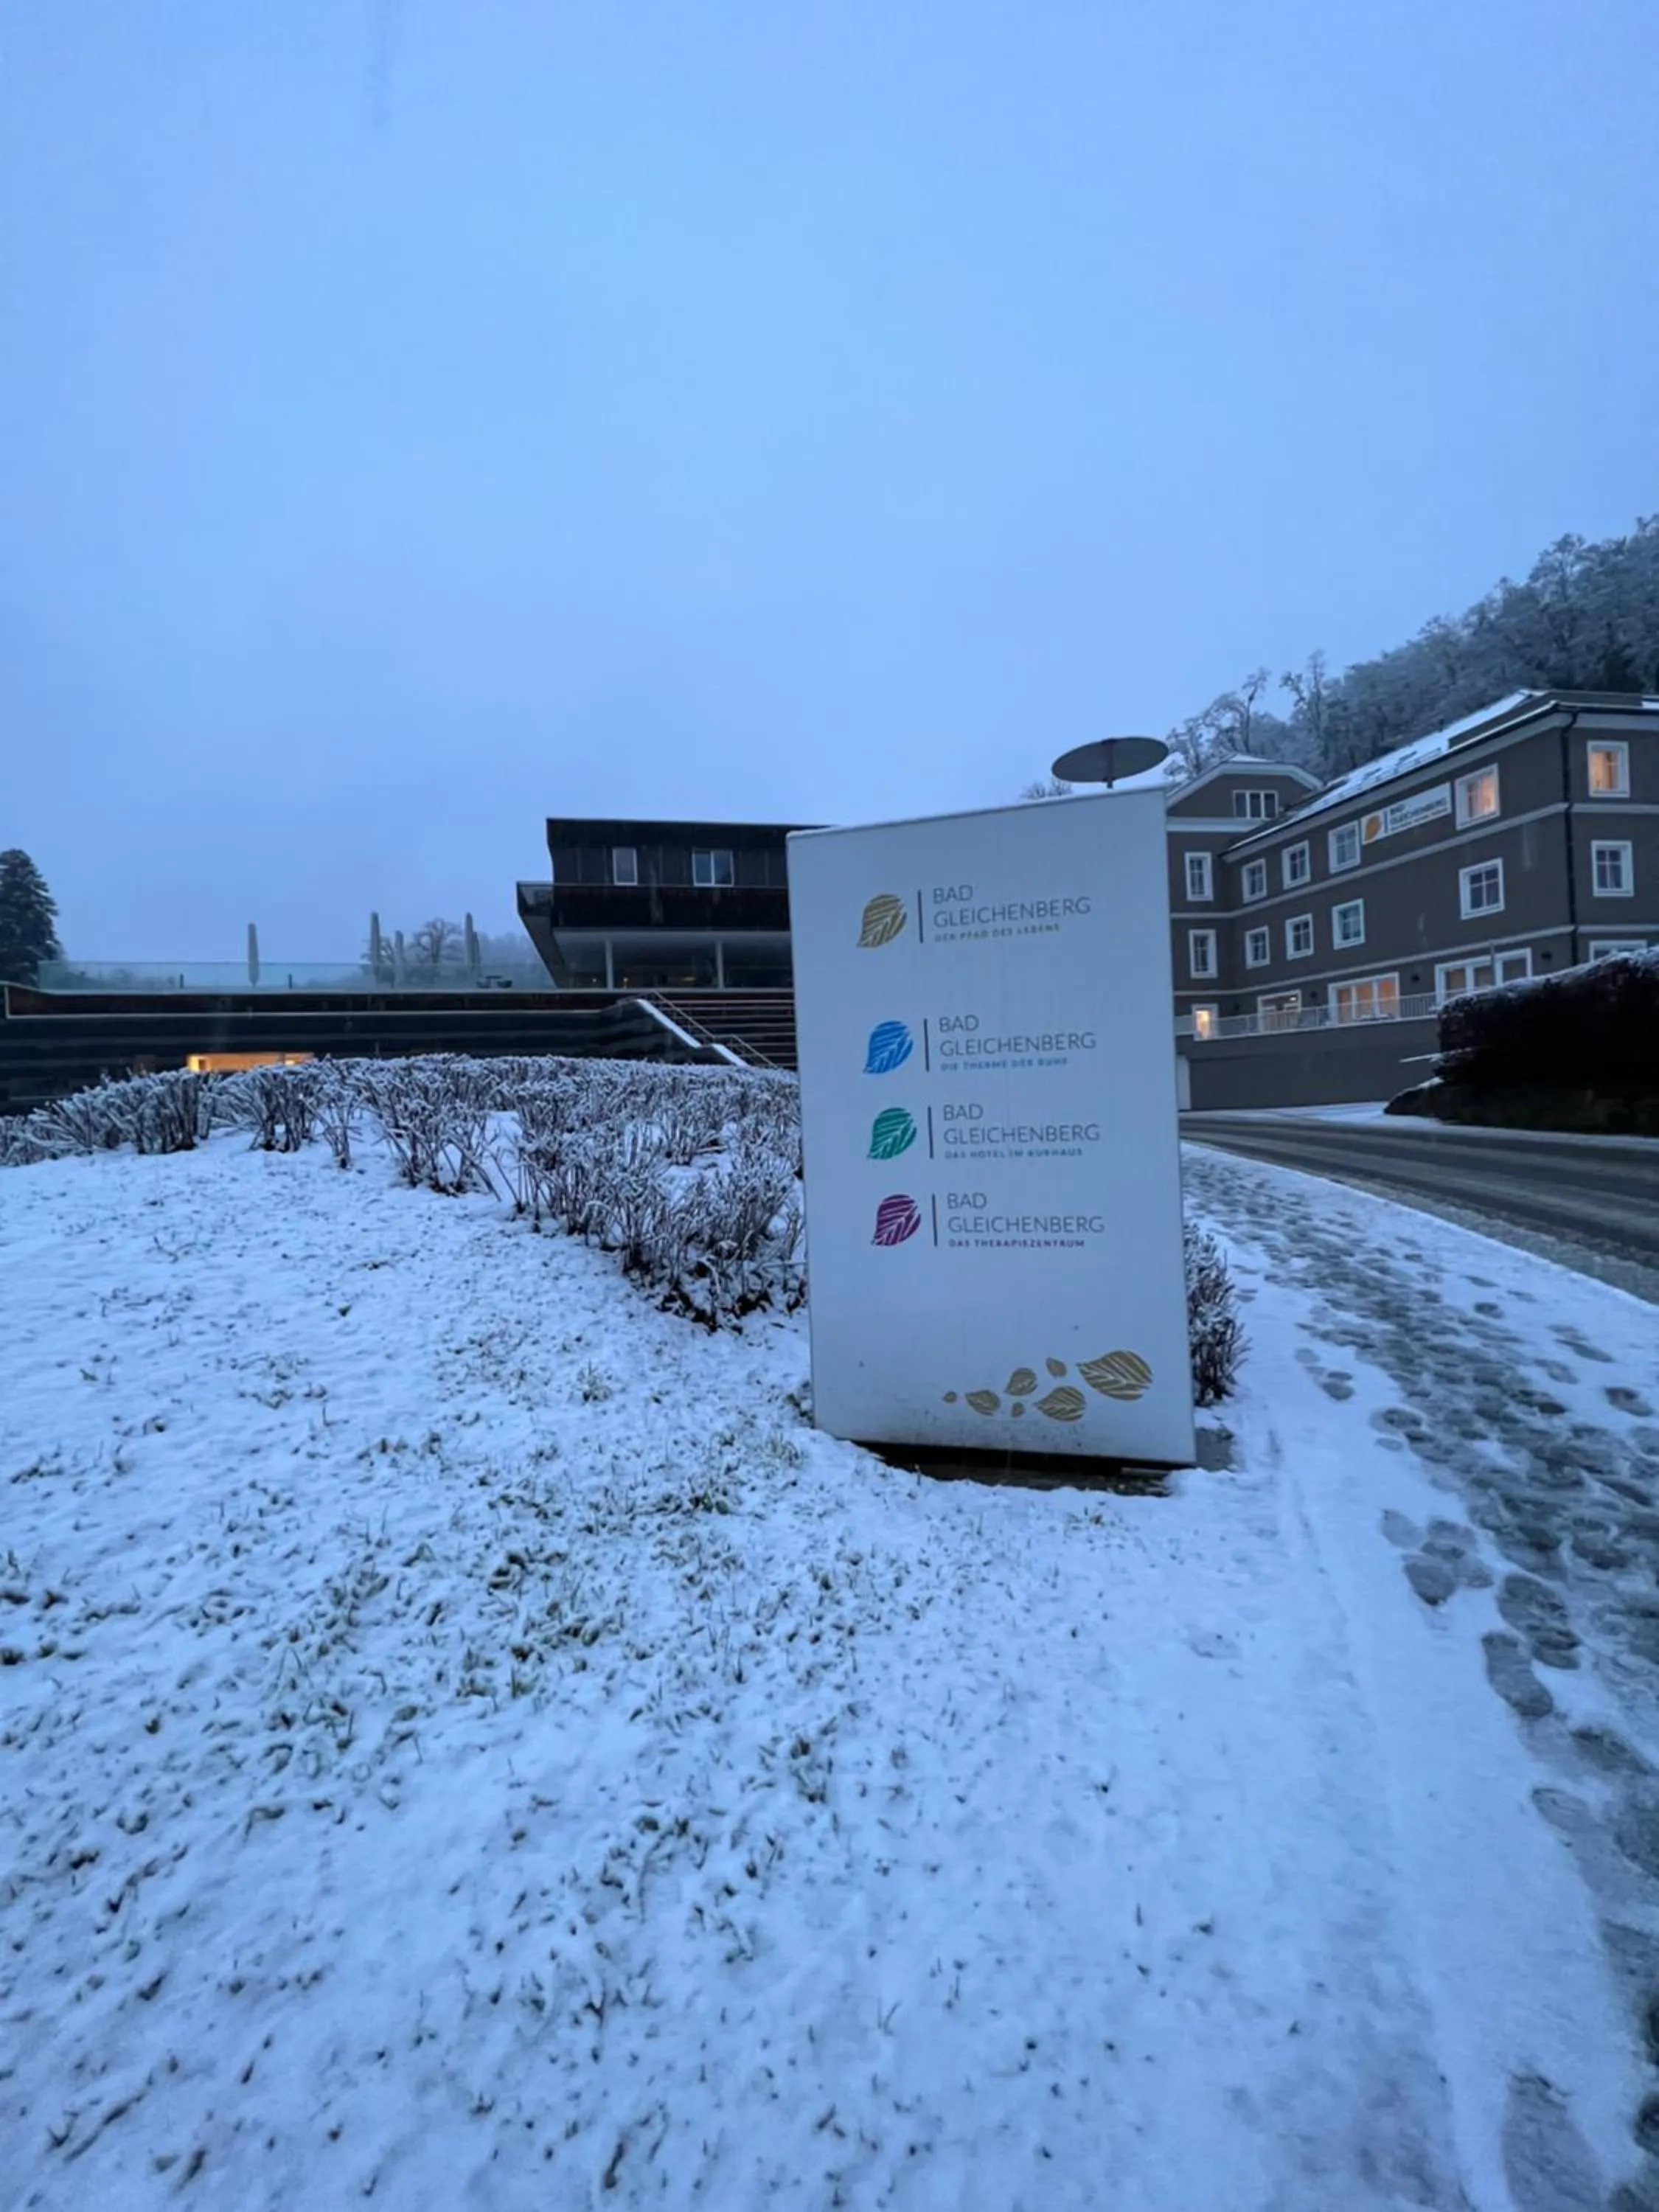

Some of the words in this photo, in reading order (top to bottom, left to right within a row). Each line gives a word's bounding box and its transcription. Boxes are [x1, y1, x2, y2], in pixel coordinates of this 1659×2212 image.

[933, 885, 973, 904] BAD
[933, 896, 1091, 928] GLEICHENBERG
[960, 928, 989, 940] PFAD
[939, 1015, 979, 1032] BAD
[939, 1032, 1097, 1057] GLEICHENBERG
[943, 1104, 984, 1121] BAD
[943, 1124, 1101, 1144] GLEICHENBERG
[945, 1150, 966, 1159] DAS
[970, 1149, 1005, 1159] HOTEL
[1009, 1149, 1023, 1158] IM
[947, 1192, 987, 1209] BAD
[947, 1217, 1105, 1234] GLEICHENBERG
[948, 1239, 970, 1248] DAS
[974, 1239, 1085, 1248] THERAPIEZENTRUM
